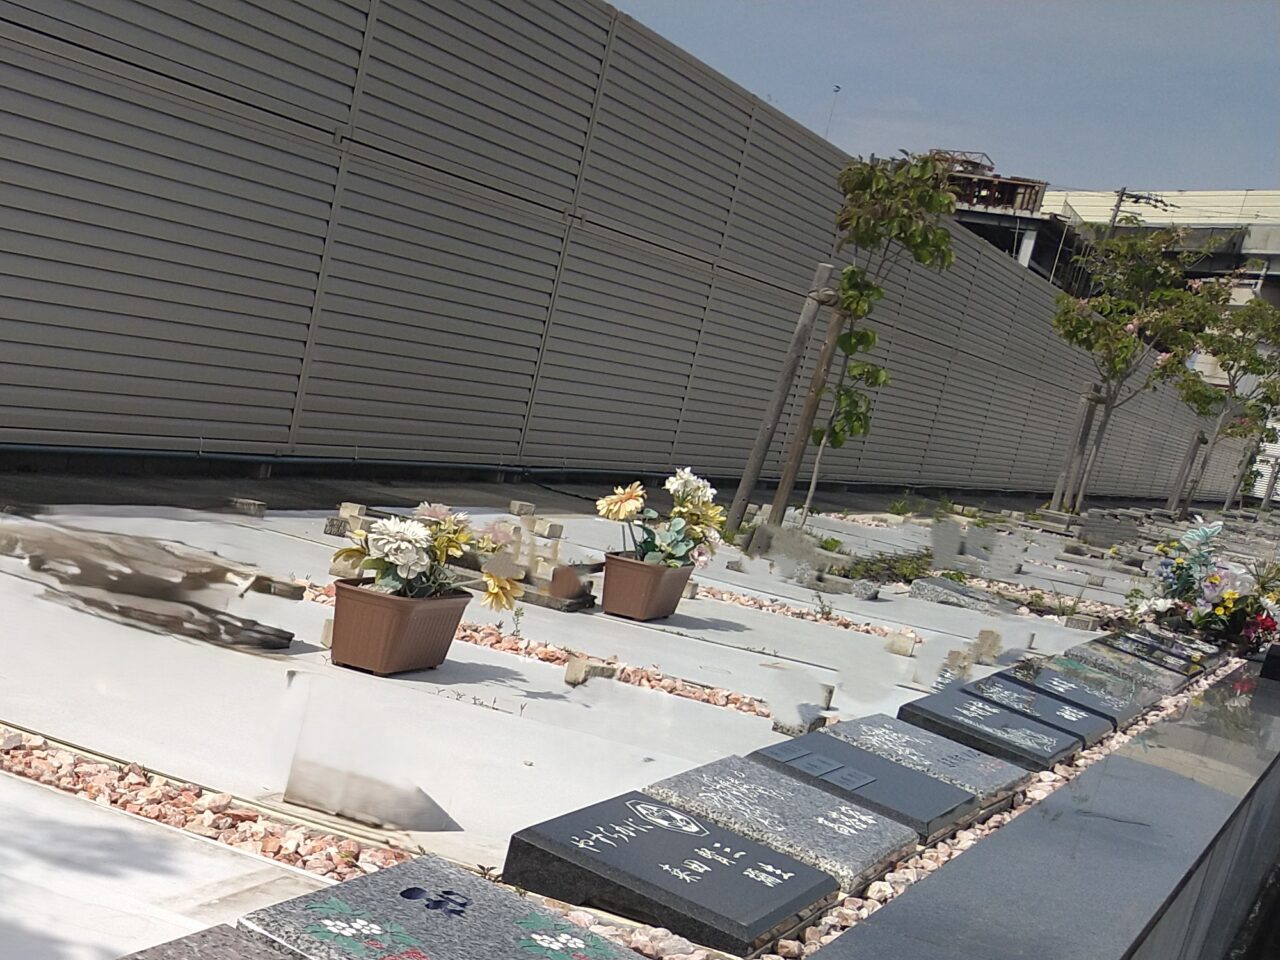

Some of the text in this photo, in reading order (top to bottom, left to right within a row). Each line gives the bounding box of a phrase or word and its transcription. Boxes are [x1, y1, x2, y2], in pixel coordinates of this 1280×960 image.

[570, 818, 654, 852] やすらかに
